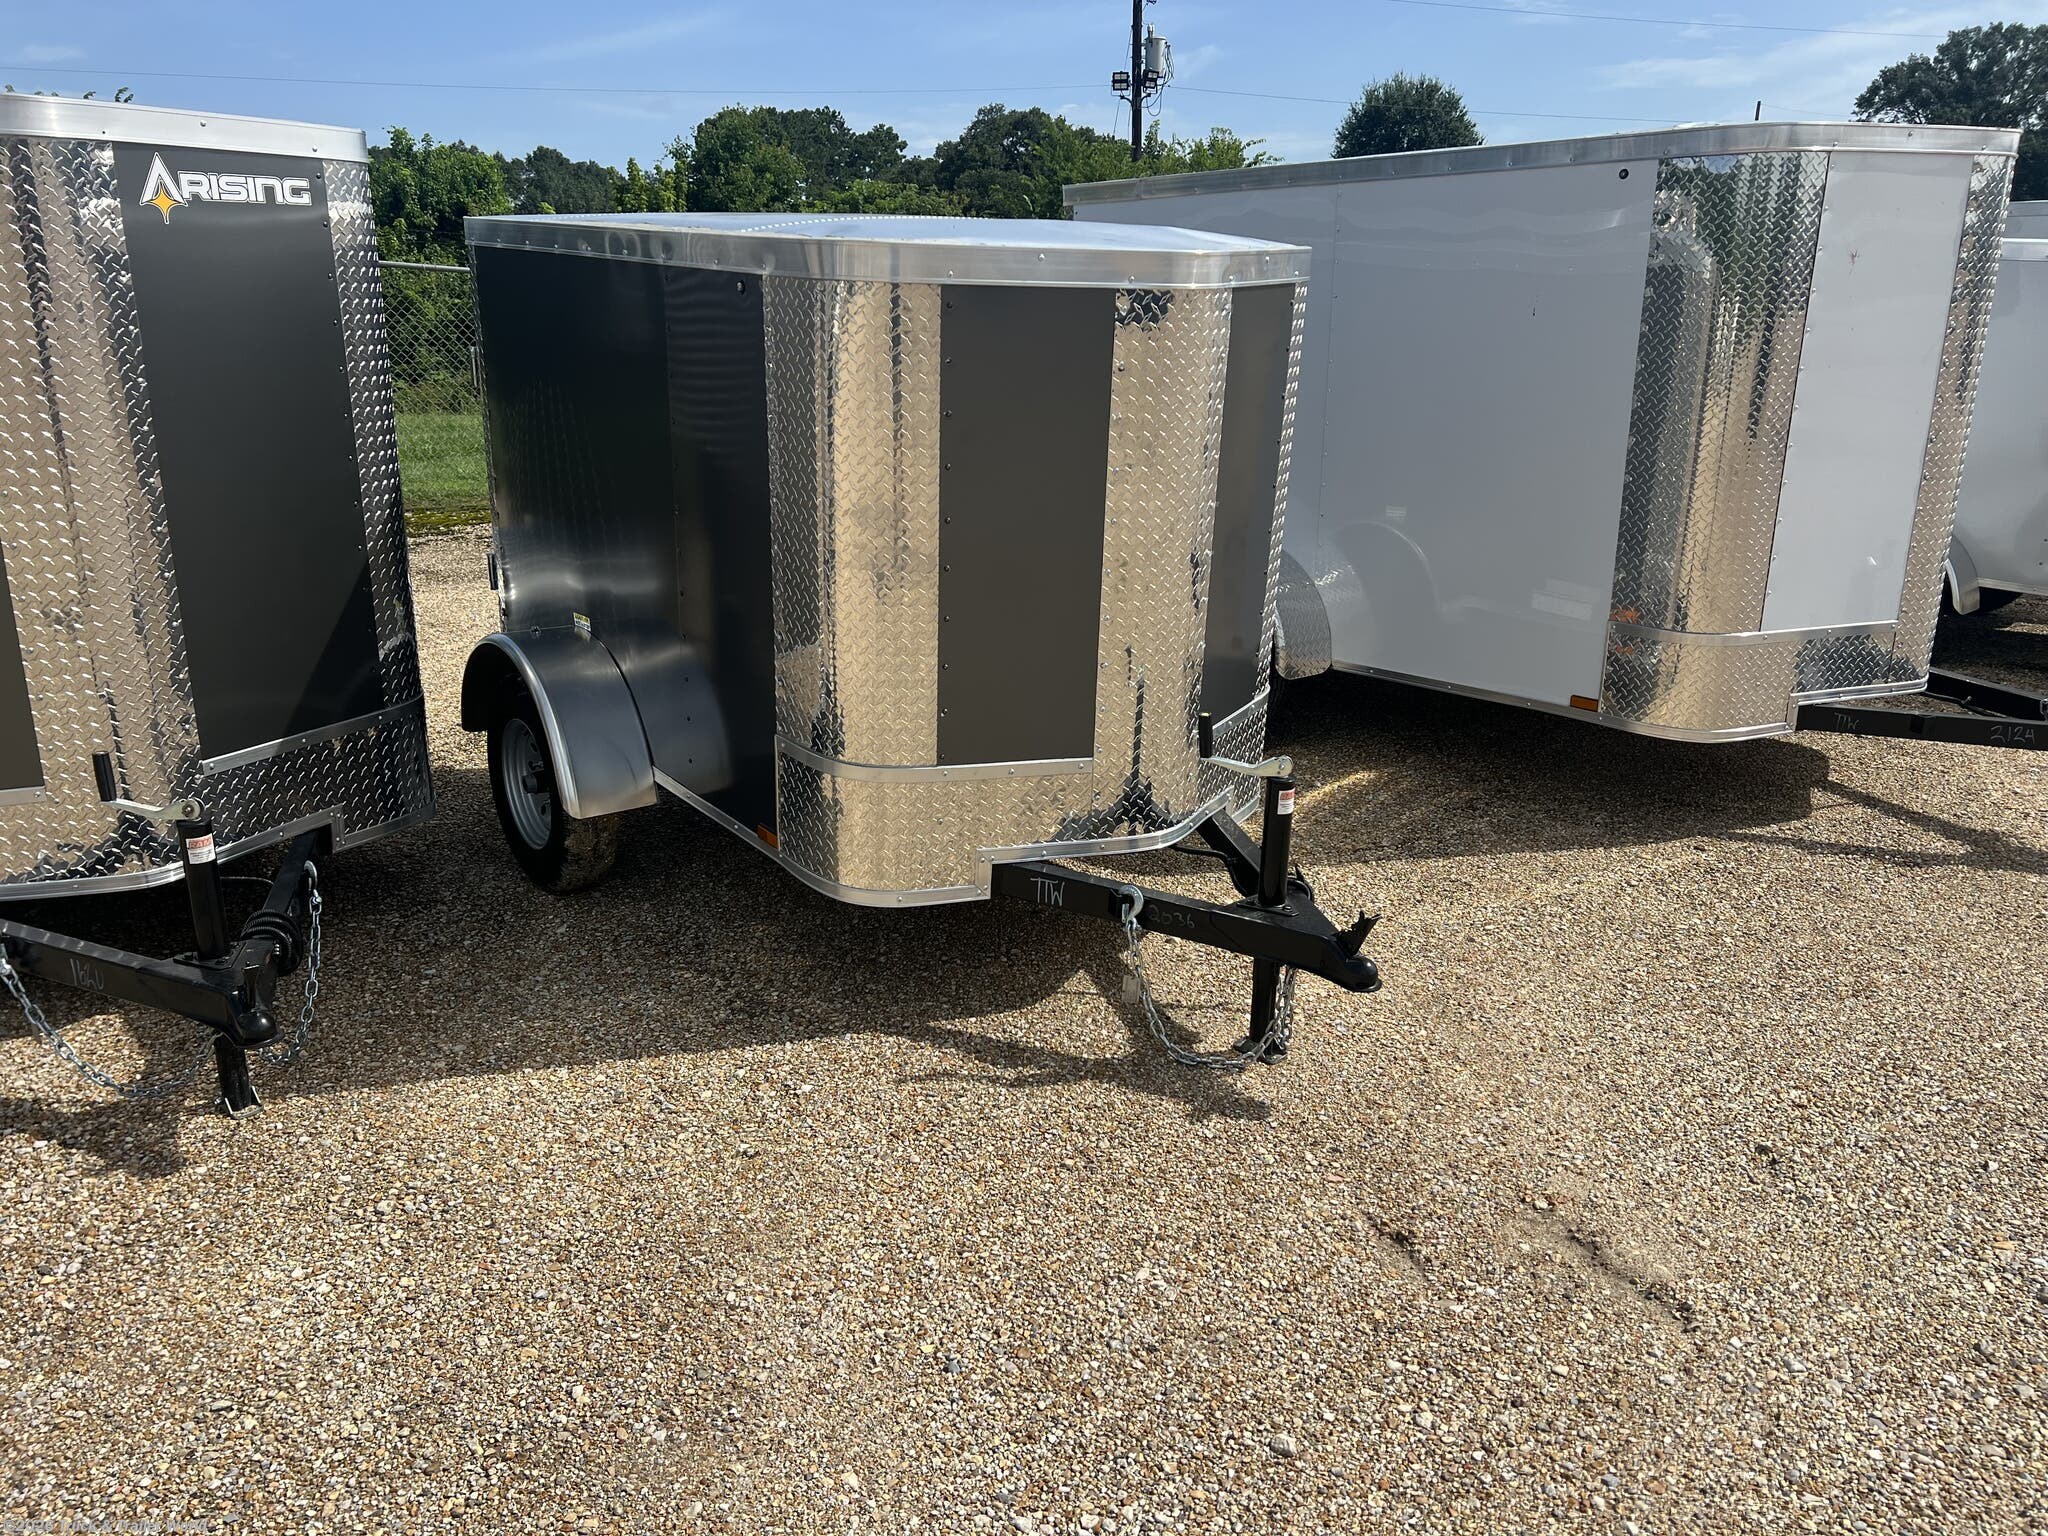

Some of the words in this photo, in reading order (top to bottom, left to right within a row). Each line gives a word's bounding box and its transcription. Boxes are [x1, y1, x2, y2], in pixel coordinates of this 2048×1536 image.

[139, 152, 312, 206] ARISING
[1990, 725, 2036, 745] 2124
[1030, 877, 1065, 907] TTW
